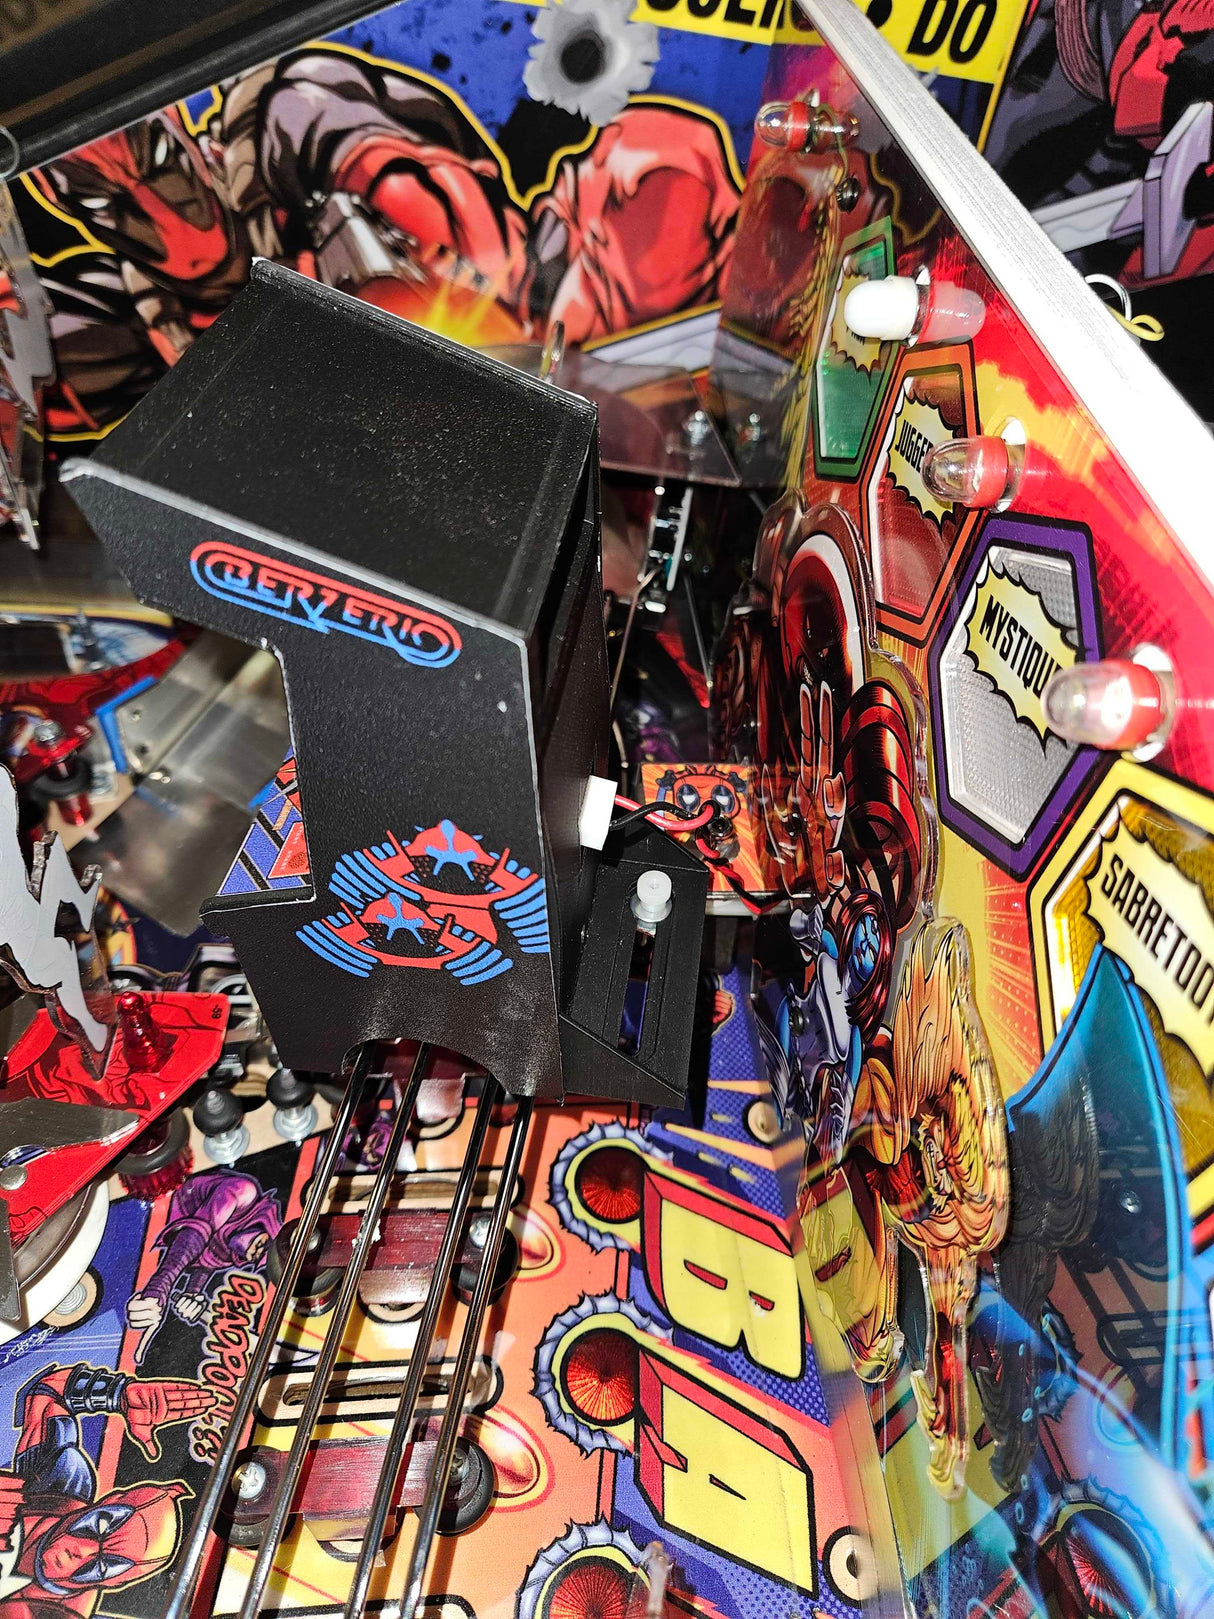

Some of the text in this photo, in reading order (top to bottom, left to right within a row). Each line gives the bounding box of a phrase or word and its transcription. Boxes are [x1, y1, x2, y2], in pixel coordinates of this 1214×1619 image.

[906, 0, 998, 64] DO
[895, 419, 934, 473] JUGGE
[979, 594, 1063, 699] MYSTIQU
[1101, 854, 1214, 1026] SABRETOO
